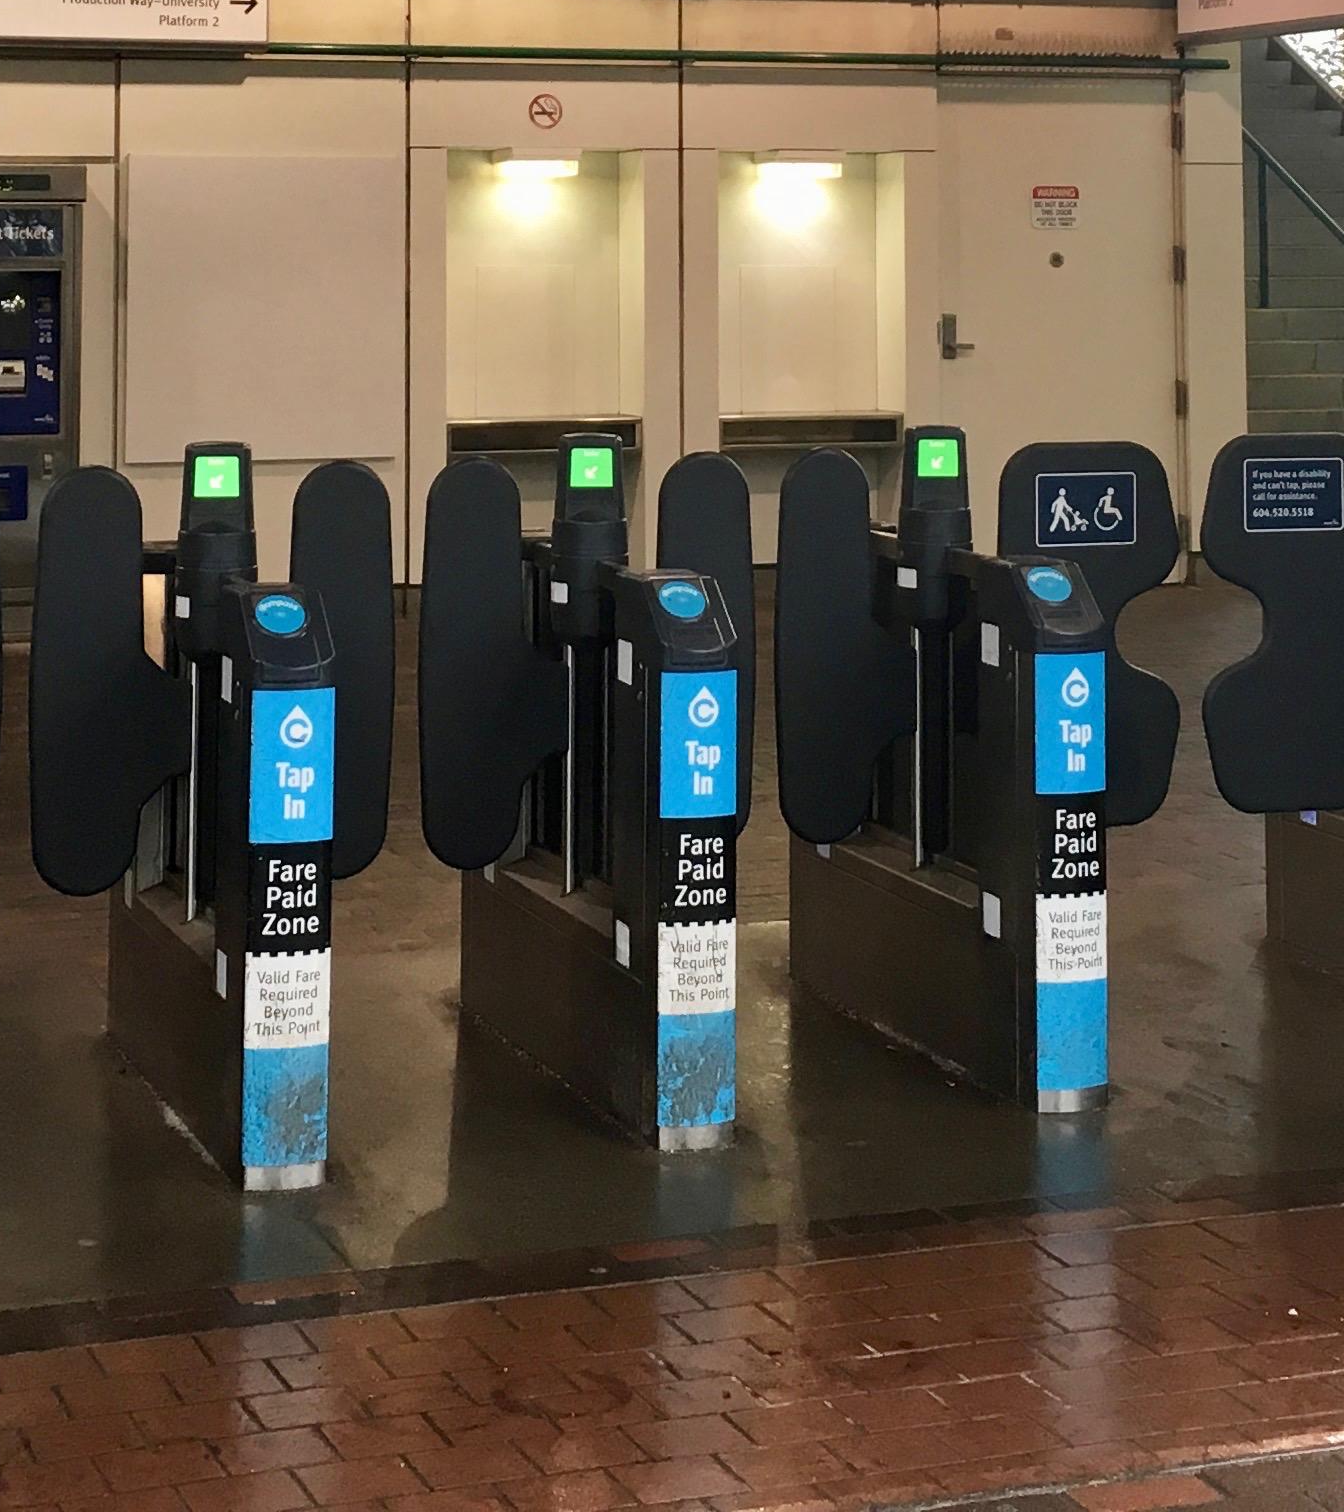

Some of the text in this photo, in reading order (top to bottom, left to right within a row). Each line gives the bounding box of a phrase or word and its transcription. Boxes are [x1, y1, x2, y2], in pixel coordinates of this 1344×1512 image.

[158, 14, 220, 28] Platform 2
[4, 226, 54, 240] Tickets
[1273, 470, 1291, 478] have
[1298, 470, 1331, 479] disability
[1267, 492, 1278, 500] for
[1059, 720, 1092, 748] Tap
[685, 740, 720, 770] Tap
[1067, 749, 1085, 772] In
[276, 762, 314, 793] Tap
[693, 771, 713, 795] In
[284, 794, 305, 819] In
[1056, 809, 1096, 830] Fare
[680, 834, 724, 856] Fare
[1055, 832, 1096, 855] Paid
[268, 860, 317, 882] Fare
[678, 858, 724, 880] Paid
[1051, 858, 1100, 879] Zone
[266, 885, 317, 909] Paid
[674, 885, 727, 907] Zone
[1049, 909, 1102, 923] Valid Fare
[262, 913, 320, 936] Zone
[1051, 925, 1100, 939] Required
[671, 939, 728, 953] Valid Fare
[1056, 942, 1097, 955] Beyond
[673, 956, 726, 970] Required
[1048, 956, 1103, 971] This Point
[257, 970, 321, 984] Valid Fare
[678, 973, 723, 985] Beyond
[260, 987, 318, 1002] Required
[669, 988, 729, 1002] This Point
[264, 1005, 313, 1019] Beyond
[254, 1020, 320, 1036] This Point
